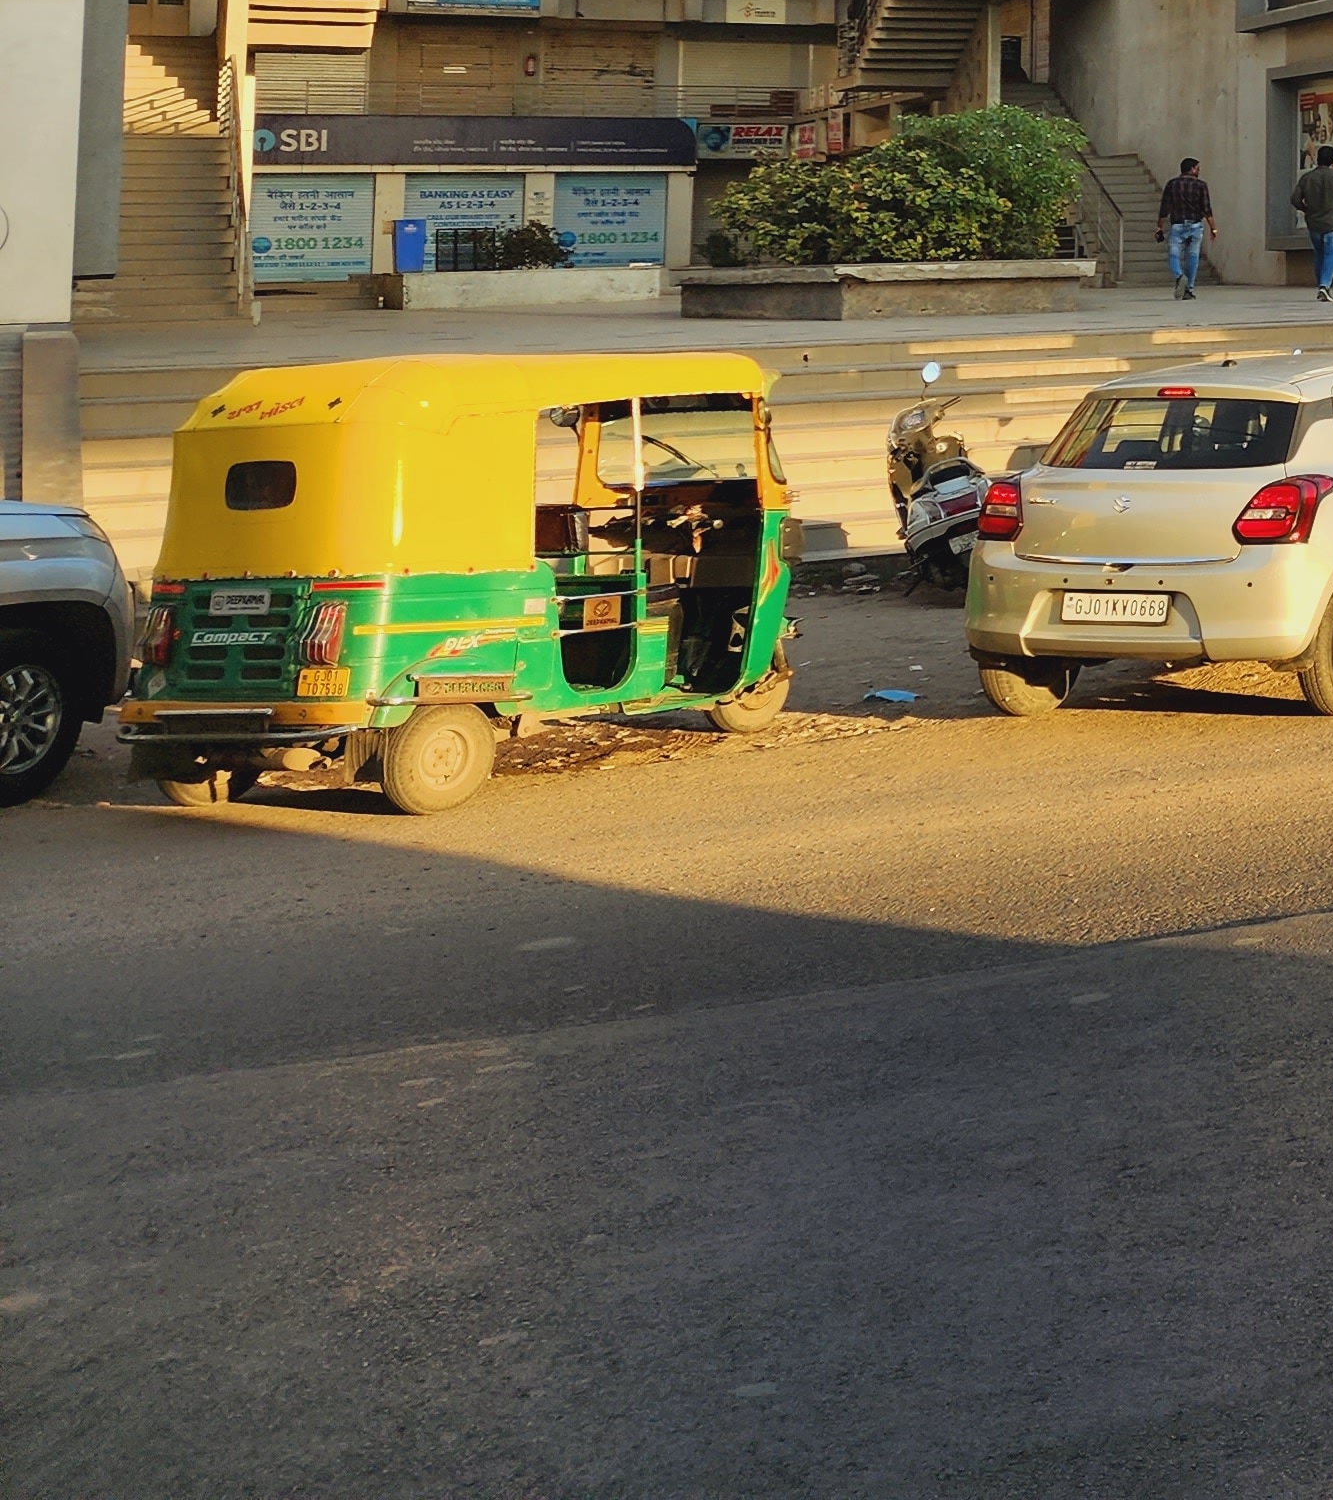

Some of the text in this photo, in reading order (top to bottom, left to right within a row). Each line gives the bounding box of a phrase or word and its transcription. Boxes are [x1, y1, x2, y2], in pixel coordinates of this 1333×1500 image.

[732, 127, 785, 137] RELAX
[279, 129, 328, 152] SBI
[419, 190, 515, 199] BANKING AS EASY
[299, 202, 341, 210] 1-2-3-4
[439, 200, 496, 209] AS 1-2-3-4
[601, 199, 640, 207] 1-2-3-4
[275, 236, 365, 250] 1800 1234
[578, 231, 660, 245] 1800 1234
[1075, 597, 1166, 617] GJ01KV0668
[445, 634, 483, 650] DLX
[313, 670, 340, 683] GJ01
